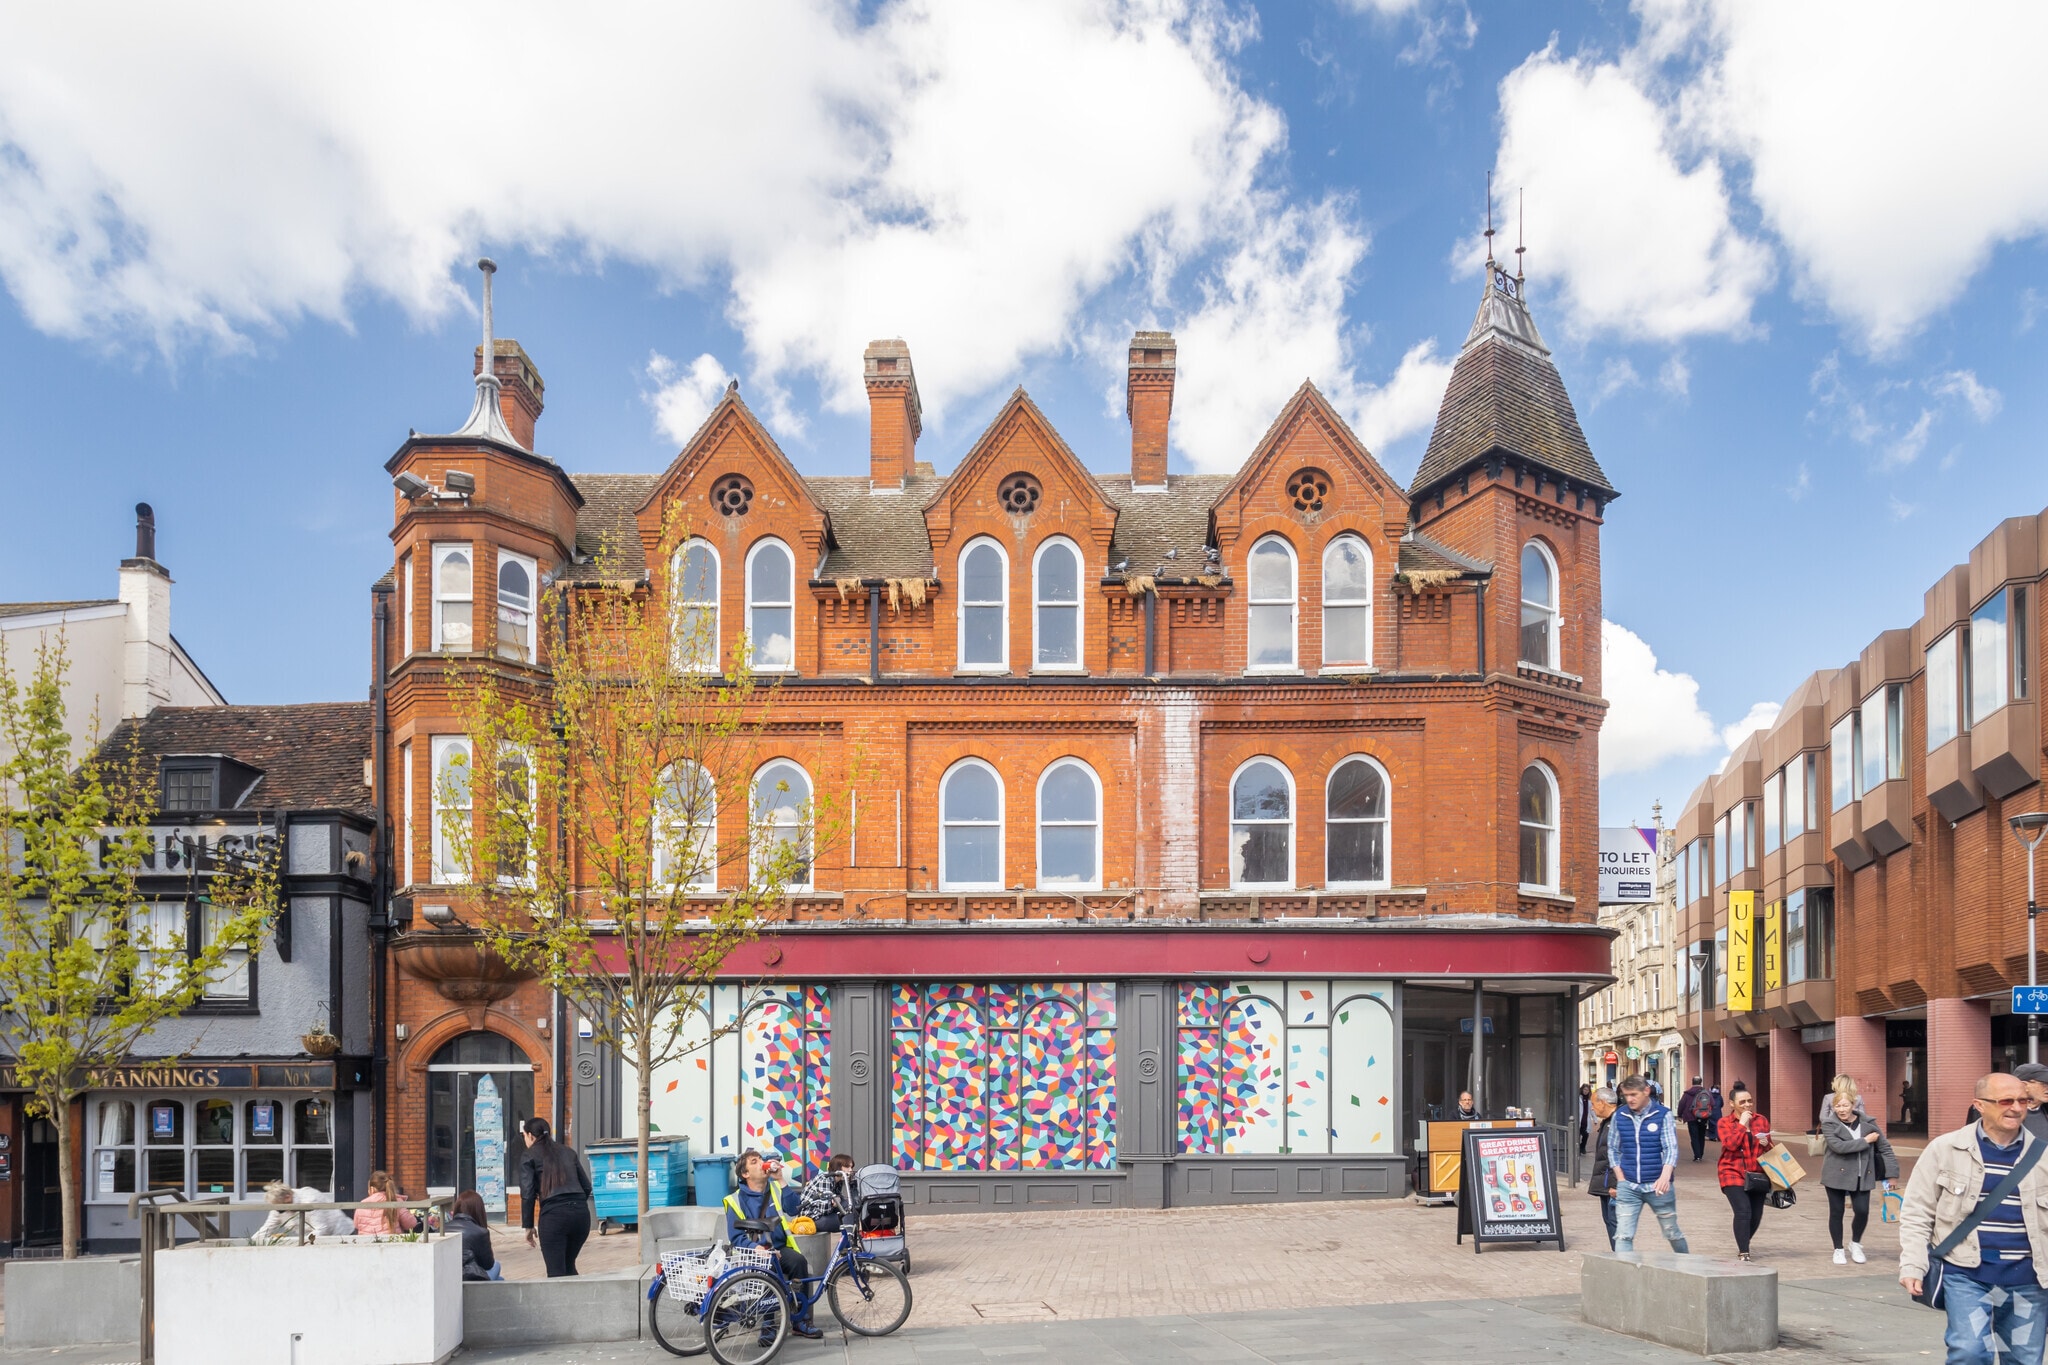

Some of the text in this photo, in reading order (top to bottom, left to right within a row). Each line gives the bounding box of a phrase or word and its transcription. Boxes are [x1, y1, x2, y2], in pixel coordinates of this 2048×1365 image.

[25, 834, 279, 870] NNING'S
[1599, 852, 1650, 863] TO LET
[1599, 867, 1650, 875] ENQUIRIES
[1733, 904, 1749, 998] UNEX
[283, 1068, 311, 1087] No 8
[1507, 1138, 1536, 1146] DRINKS
